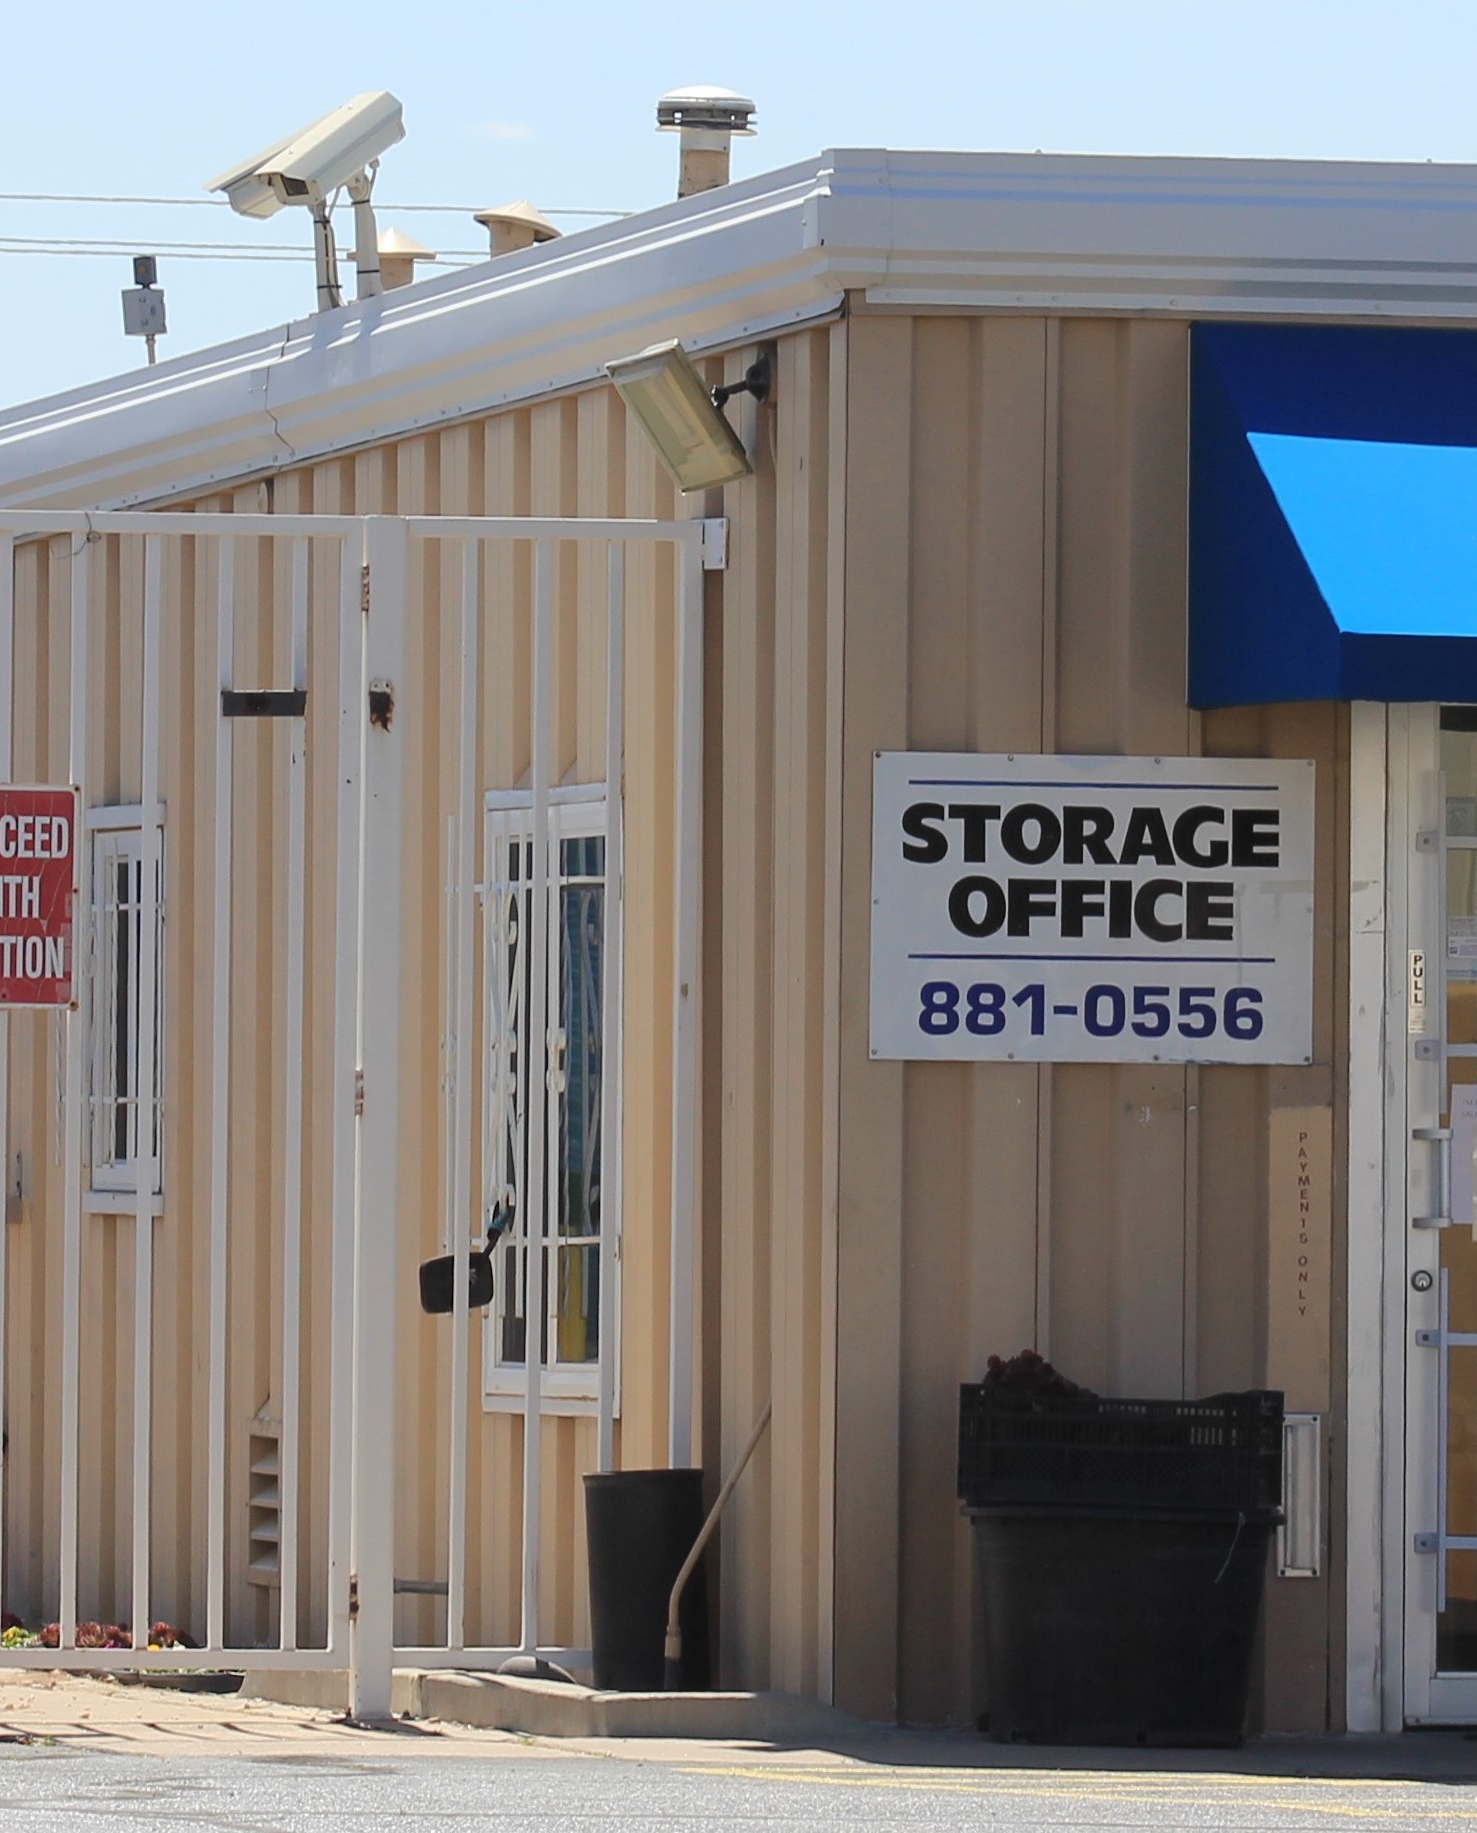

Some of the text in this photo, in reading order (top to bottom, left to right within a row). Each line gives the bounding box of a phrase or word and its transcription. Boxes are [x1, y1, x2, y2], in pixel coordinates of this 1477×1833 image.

[902, 803, 1280, 868] STORAGE
[948, 876, 1234, 942] OFFICE
[1412, 954, 1423, 1005] PULL
[918, 982, 1264, 1040] 881-0556
[1297, 1255, 1309, 1317] ONLY
